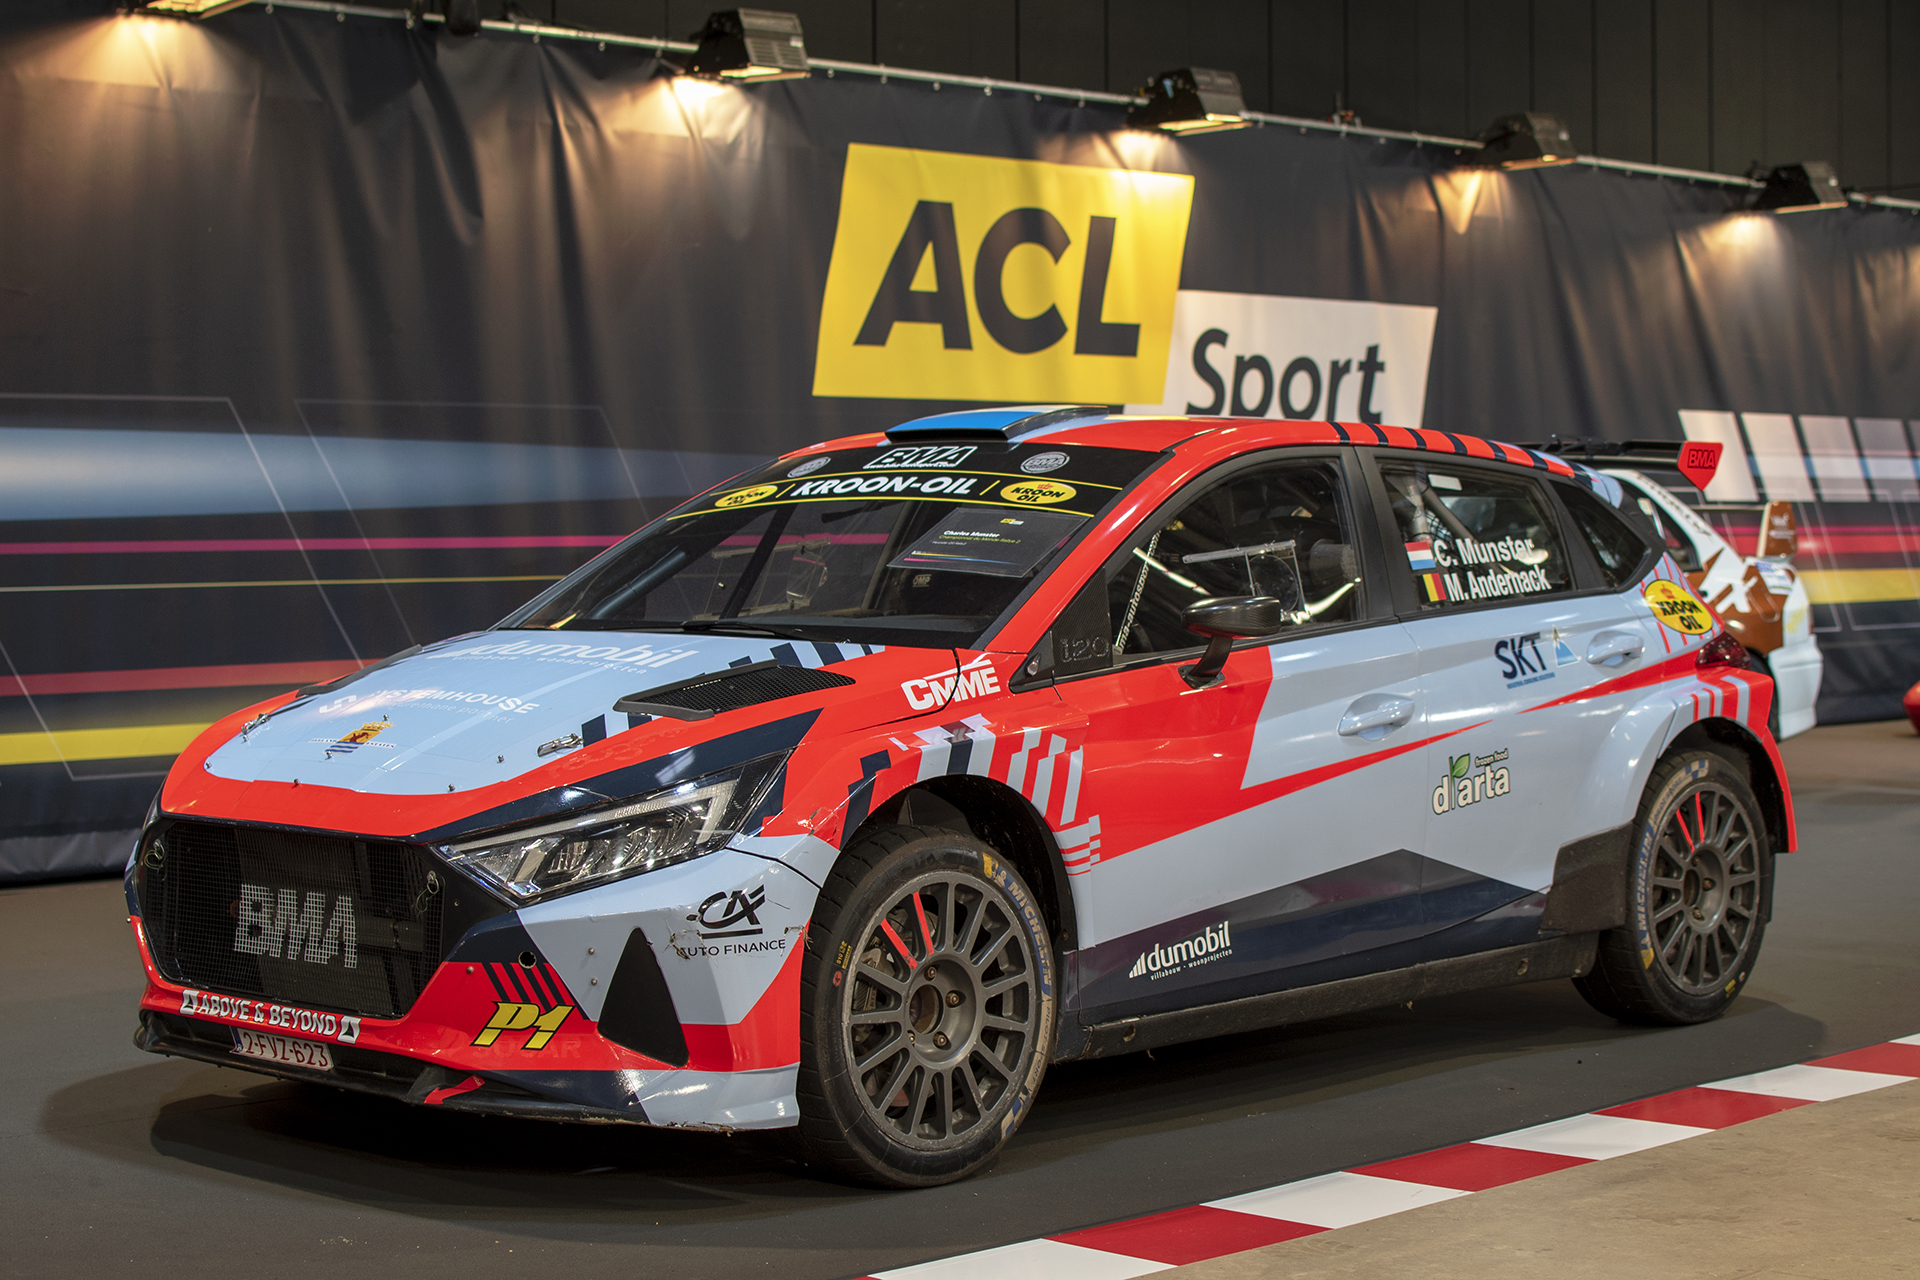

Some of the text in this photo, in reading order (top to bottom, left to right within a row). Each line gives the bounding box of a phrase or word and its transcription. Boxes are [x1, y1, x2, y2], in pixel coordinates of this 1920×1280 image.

[853, 200, 1141, 357] ACL
[1187, 328, 1386, 424] Sport
[863, 446, 978, 468] BMA
[1687, 449, 1716, 469] BMA
[790, 476, 977, 496] KROON-OIL
[1011, 487, 1066, 498] KROON
[1433, 535, 1534, 567] C. Munster
[912, 574, 932, 587] OMP
[1656, 599, 1704, 617] KROON
[1678, 615, 1704, 631] OIL
[469, 640, 700, 668] dumobil
[536, 656, 648, 675] woonprojecten
[1494, 631, 1547, 680] SKT
[900, 666, 1001, 711] CMME
[455, 706, 515, 724] partner
[1475, 748, 1508, 768] frozen food
[1637, 831, 1653, 931] MICHELIN
[234, 883, 358, 969] BMA
[1007, 881, 1053, 987] MICHELIN
[724, 938, 786, 955] FINANCE
[1147, 920, 1231, 973] dumobil
[1150, 965, 1182, 981] villabouw
[1188, 948, 1233, 968] woonprojecten
[197, 994, 338, 1037] ABOVE & BEYOND
[469, 1001, 577, 1051] P1
[1043, 1006, 1051, 1041] PILOT
[243, 1031, 329, 1068] 2-FVZ-623
